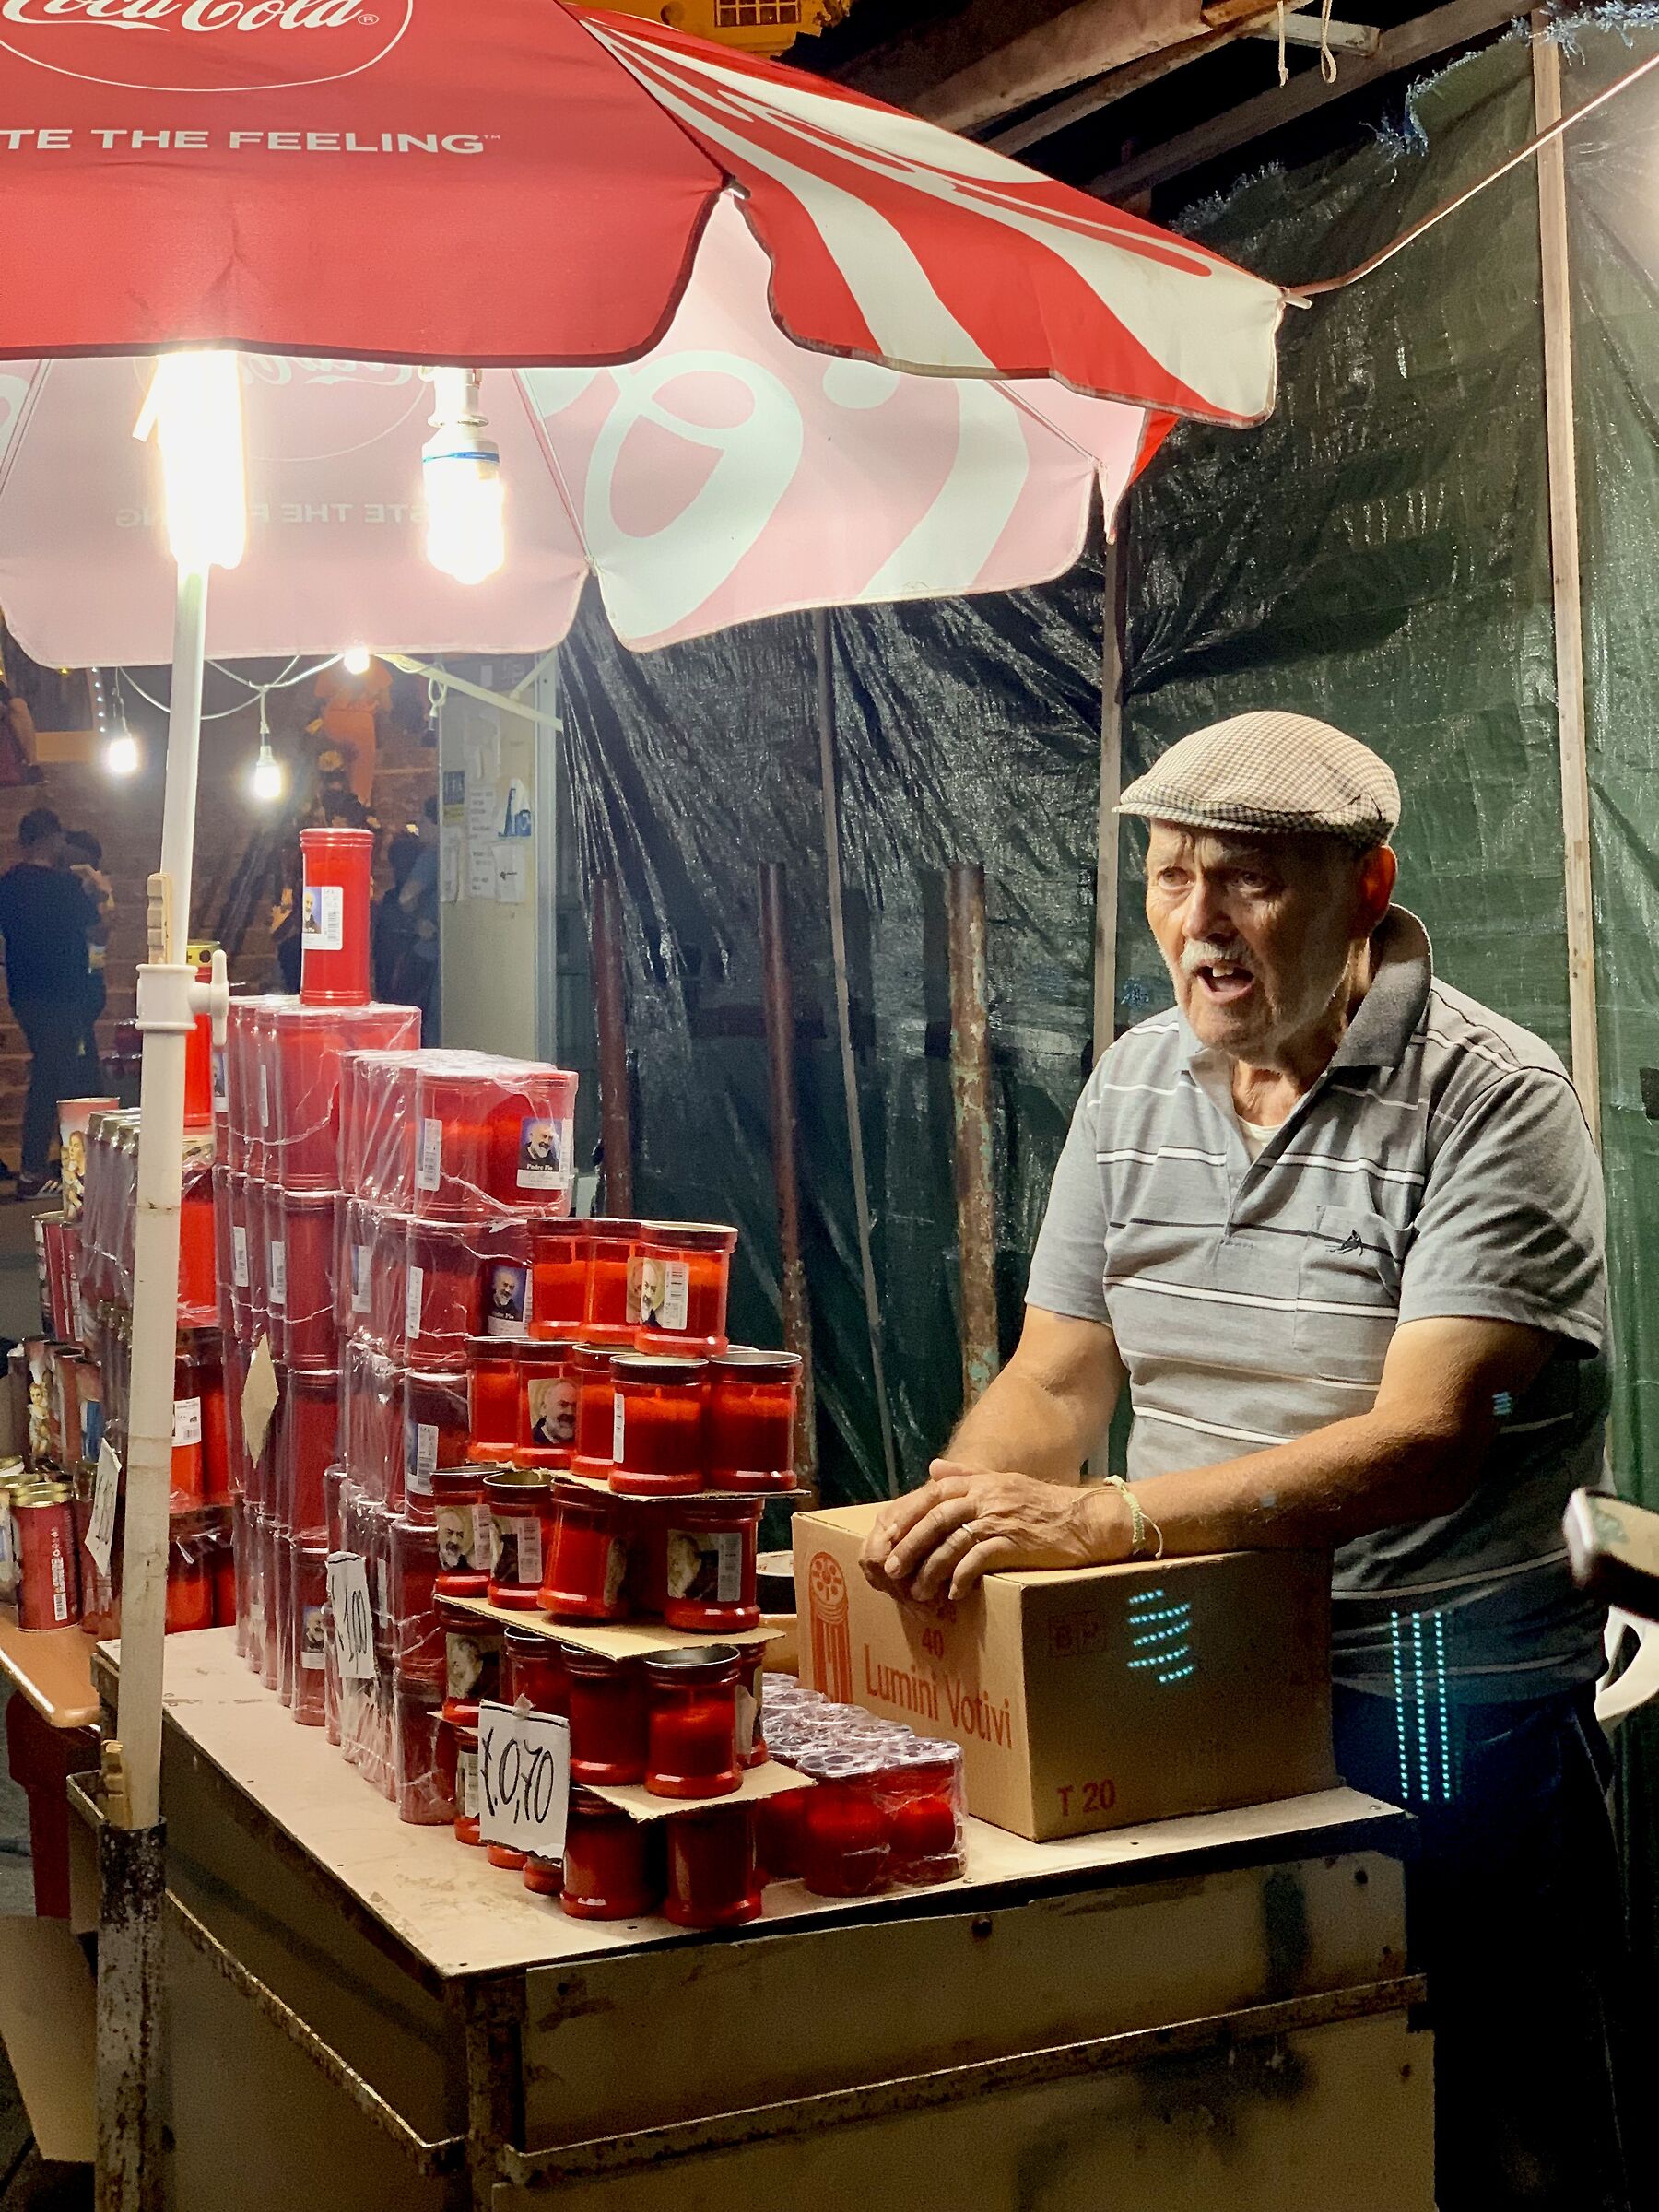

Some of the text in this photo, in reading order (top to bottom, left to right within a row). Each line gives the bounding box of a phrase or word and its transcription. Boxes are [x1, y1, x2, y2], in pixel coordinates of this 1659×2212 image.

[90, 129, 209, 149] THE
[923, 1627, 945, 1659] 40
[864, 1643, 1012, 1750] Lumini Votivi
[1057, 1778, 1117, 1818] T 20
